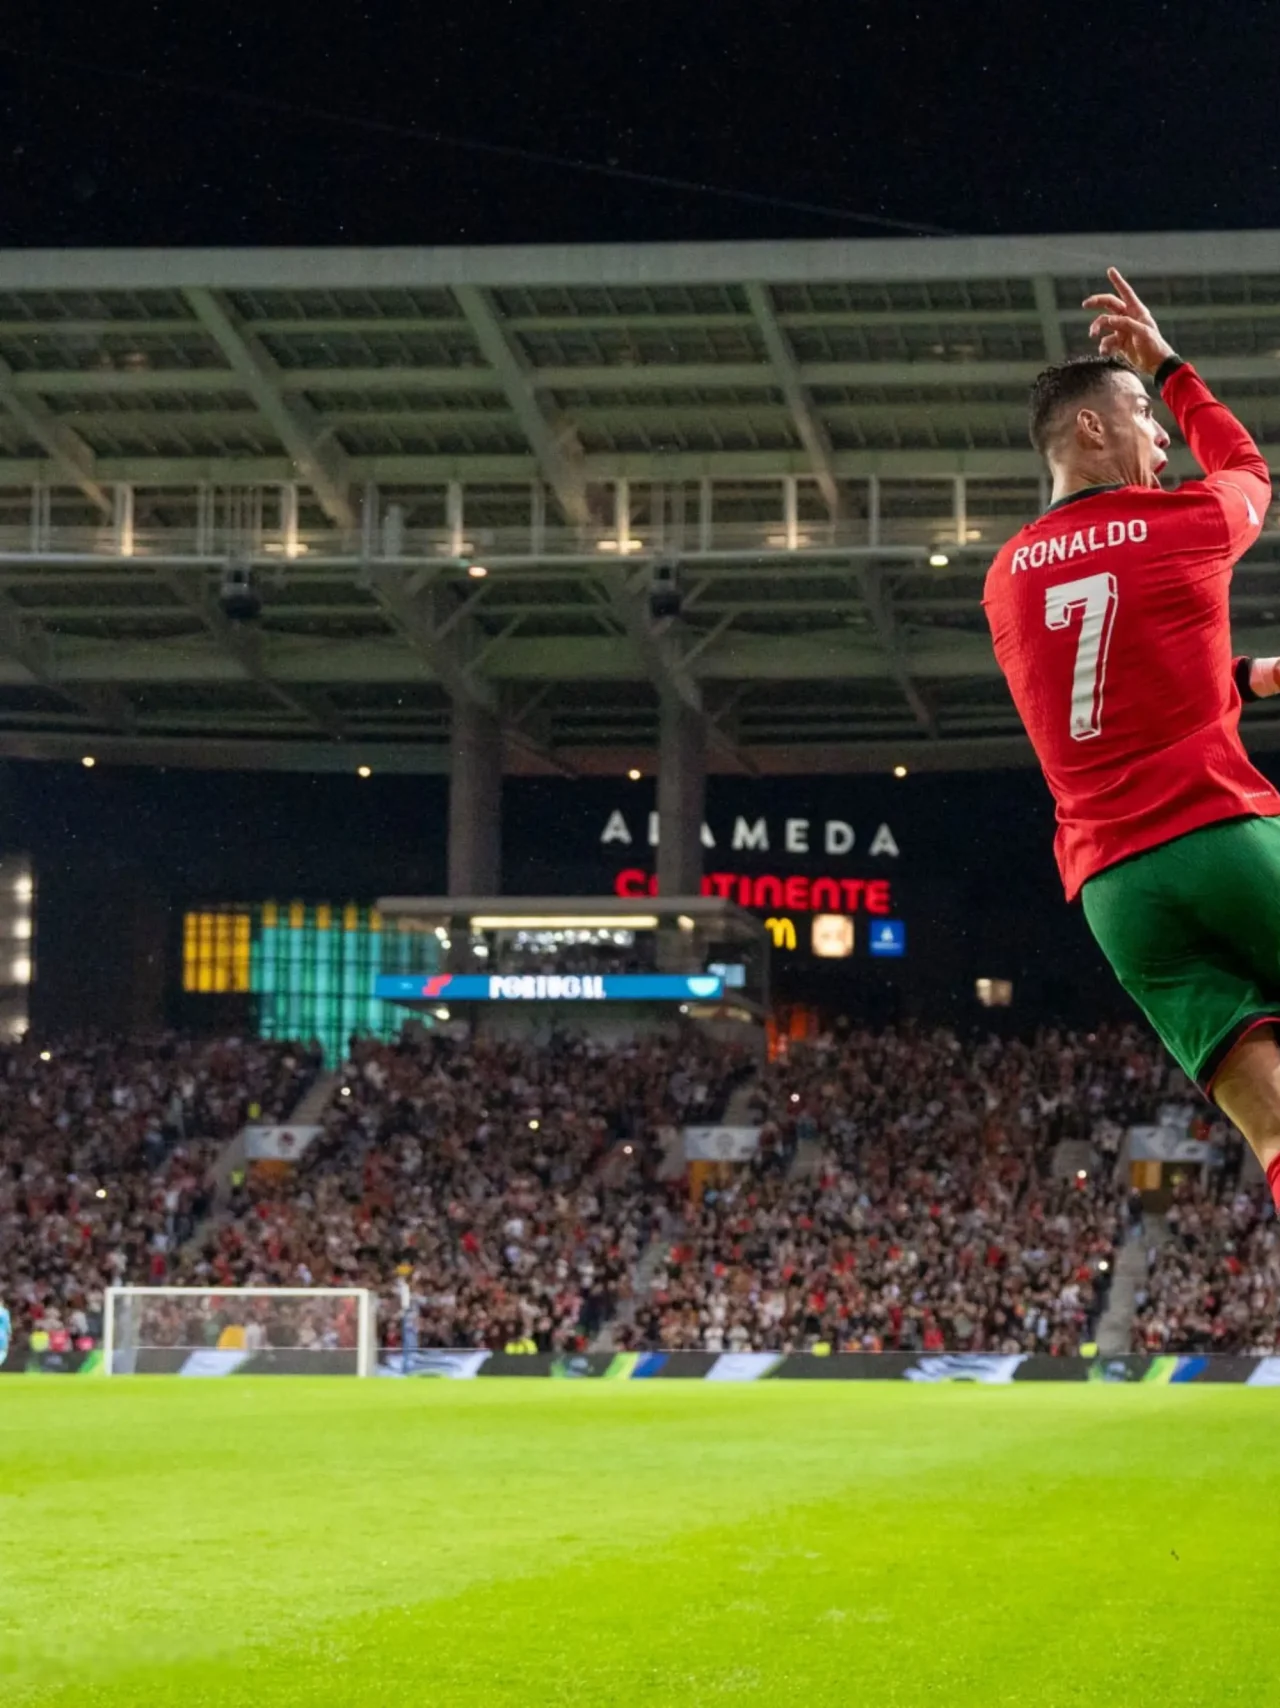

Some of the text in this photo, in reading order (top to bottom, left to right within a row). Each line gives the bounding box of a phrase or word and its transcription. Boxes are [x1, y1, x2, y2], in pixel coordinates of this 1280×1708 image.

[1011, 519, 1147, 574] RONALDO
[1045, 572, 1118, 741] 7
[615, 868, 891, 913] CTINENTE
